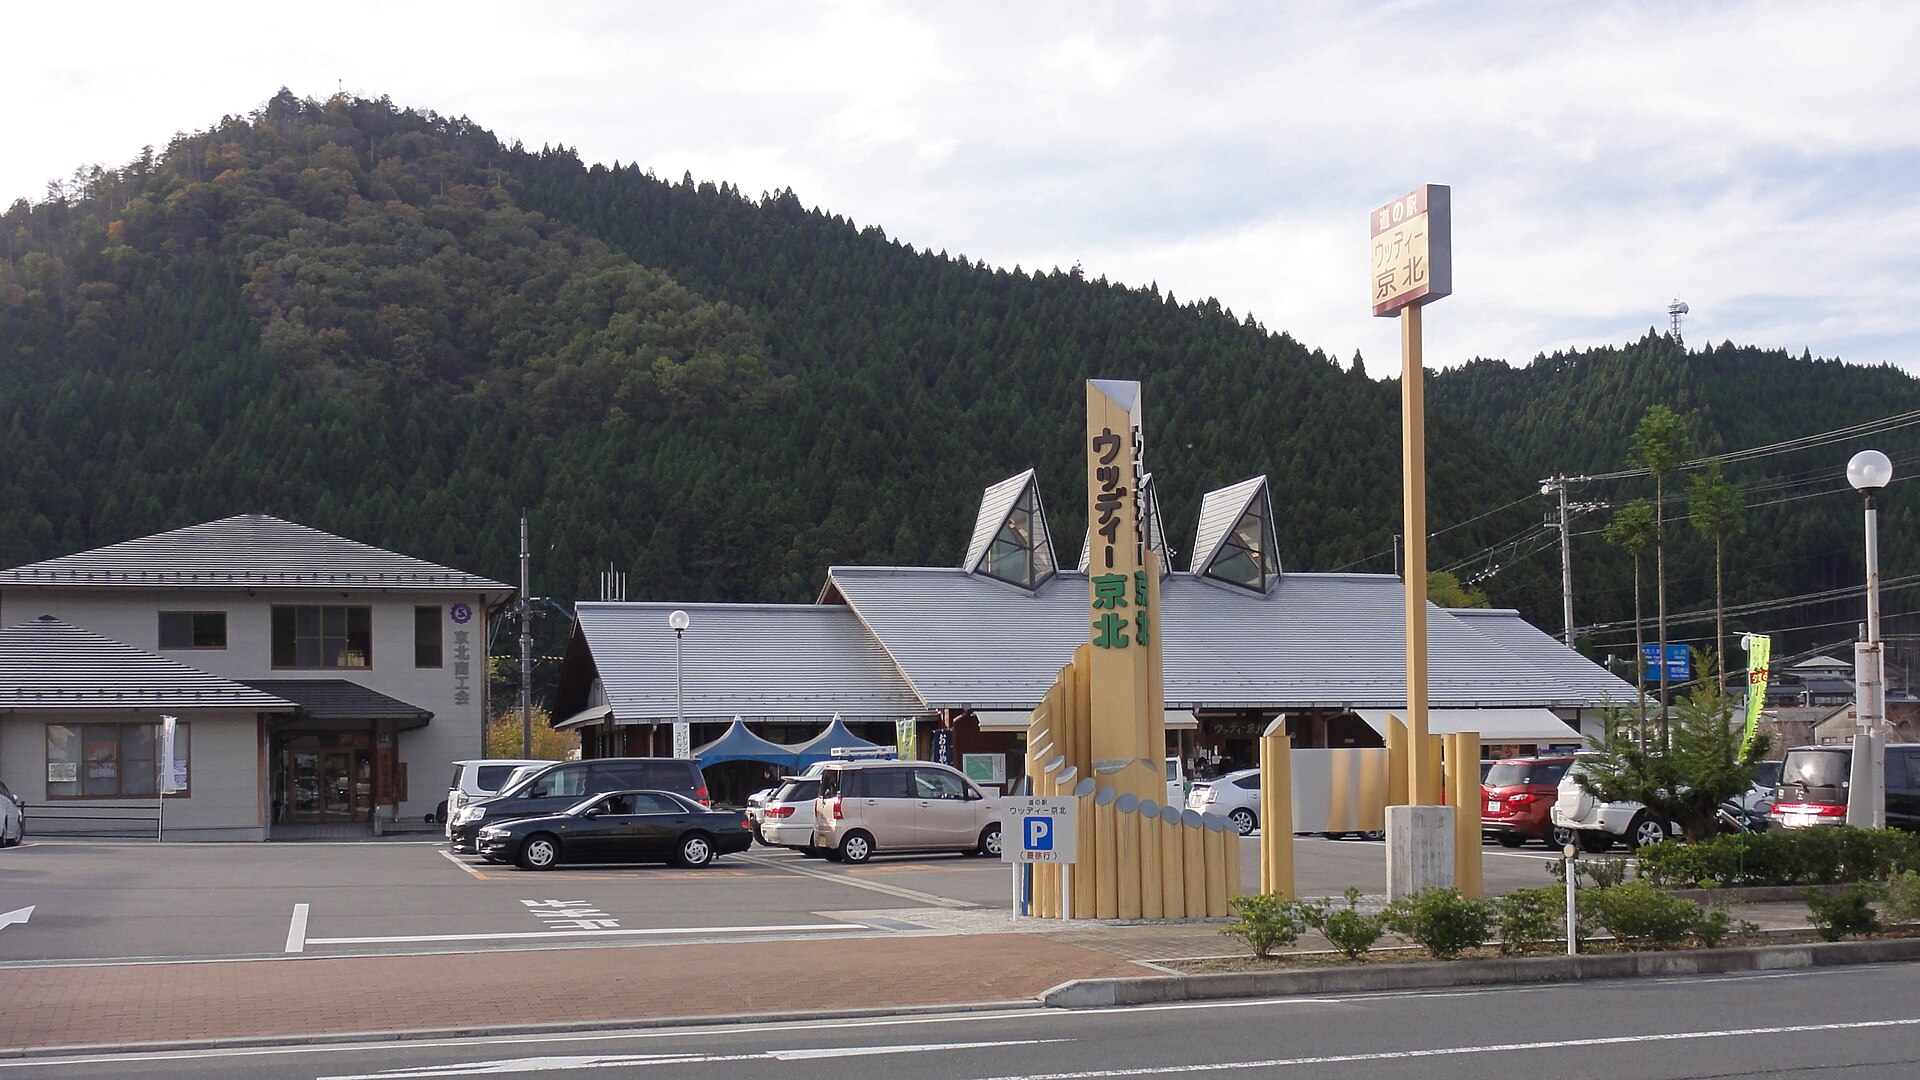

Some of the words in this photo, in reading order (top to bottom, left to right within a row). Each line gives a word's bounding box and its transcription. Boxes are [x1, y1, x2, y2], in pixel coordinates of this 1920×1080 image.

[1379, 194, 1418, 231] 道の駅
[1374, 231, 1424, 268] ウッディー
[1376, 256, 1424, 300] 京北
[1091, 427, 1129, 650] ウッディー京北
[454, 630, 470, 705] 京北商工会
[1009, 806, 1067, 815] ウッディー京北
[1030, 821, 1048, 847] P
